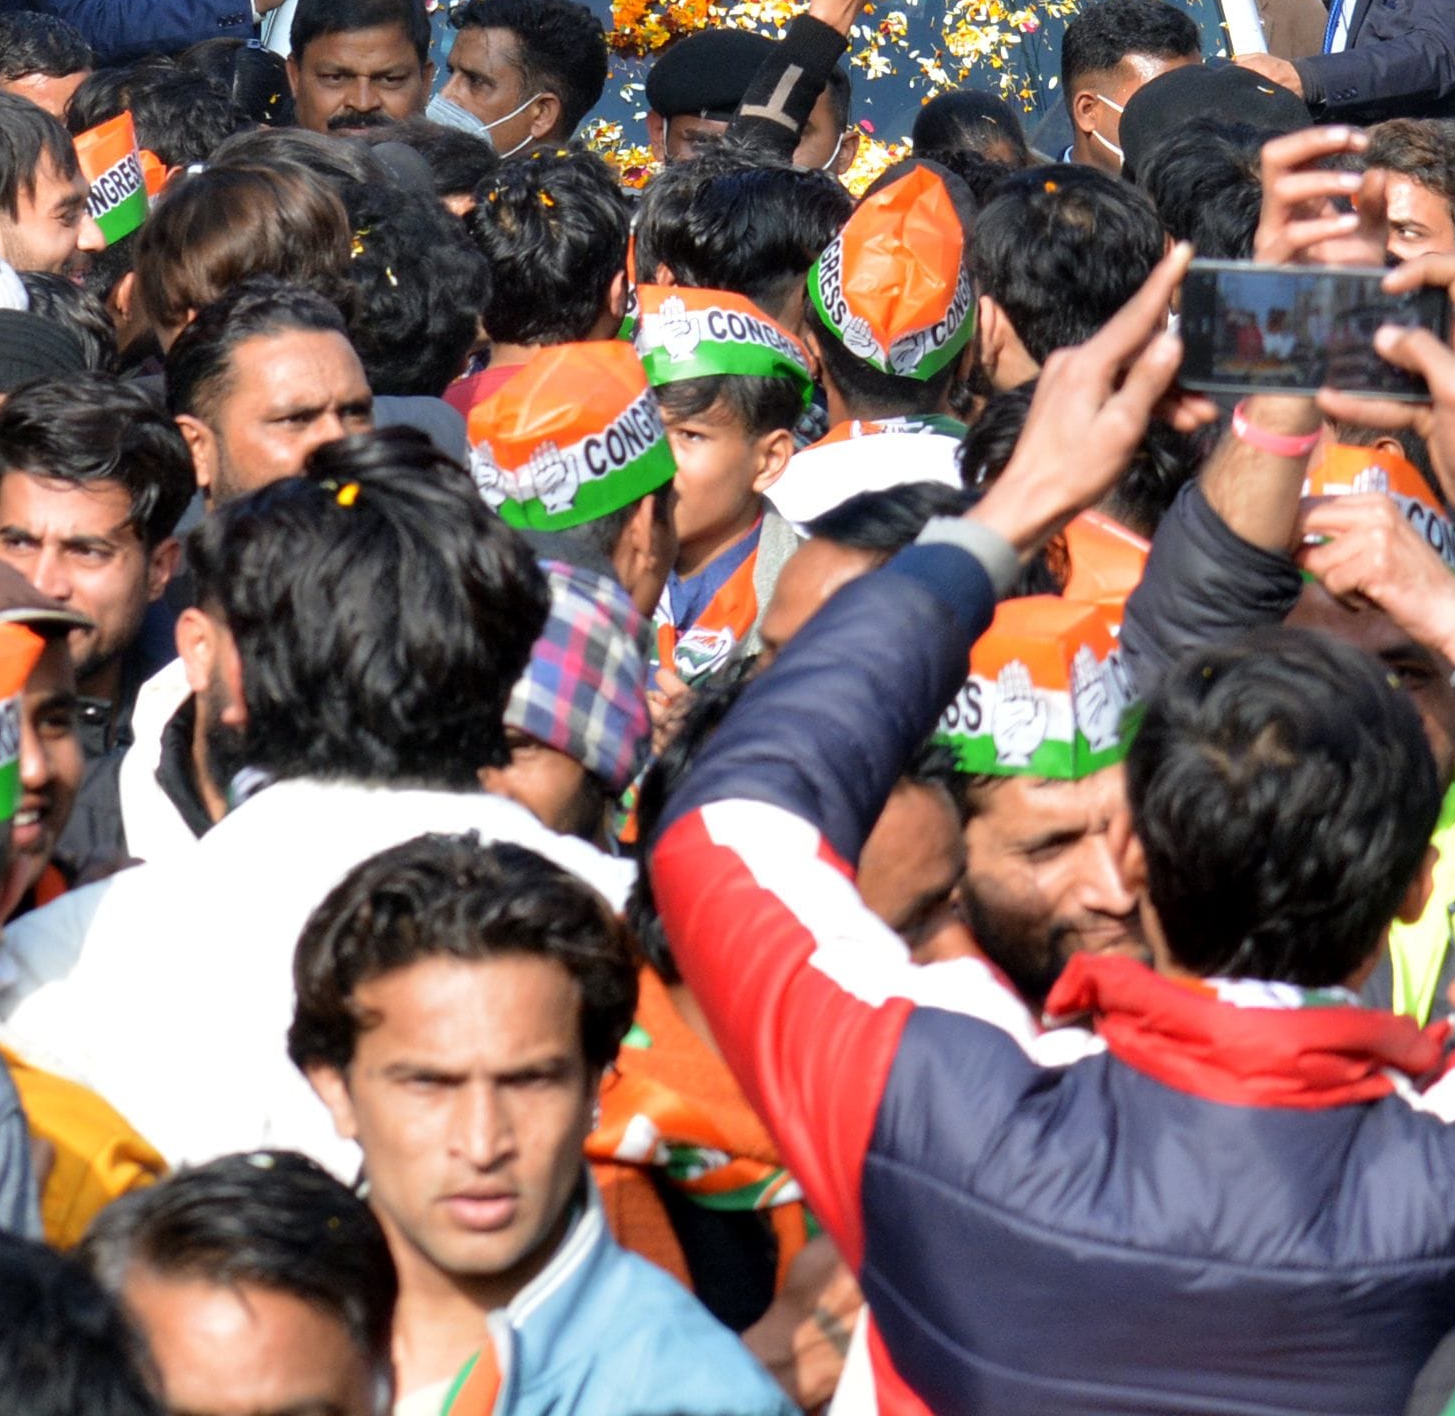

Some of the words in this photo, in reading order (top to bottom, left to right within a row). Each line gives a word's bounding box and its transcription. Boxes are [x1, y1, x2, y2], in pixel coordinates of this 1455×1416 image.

[86, 150, 142, 217] NGRES
[819, 239, 846, 326] GRESS
[582, 382, 664, 479] CONGR
